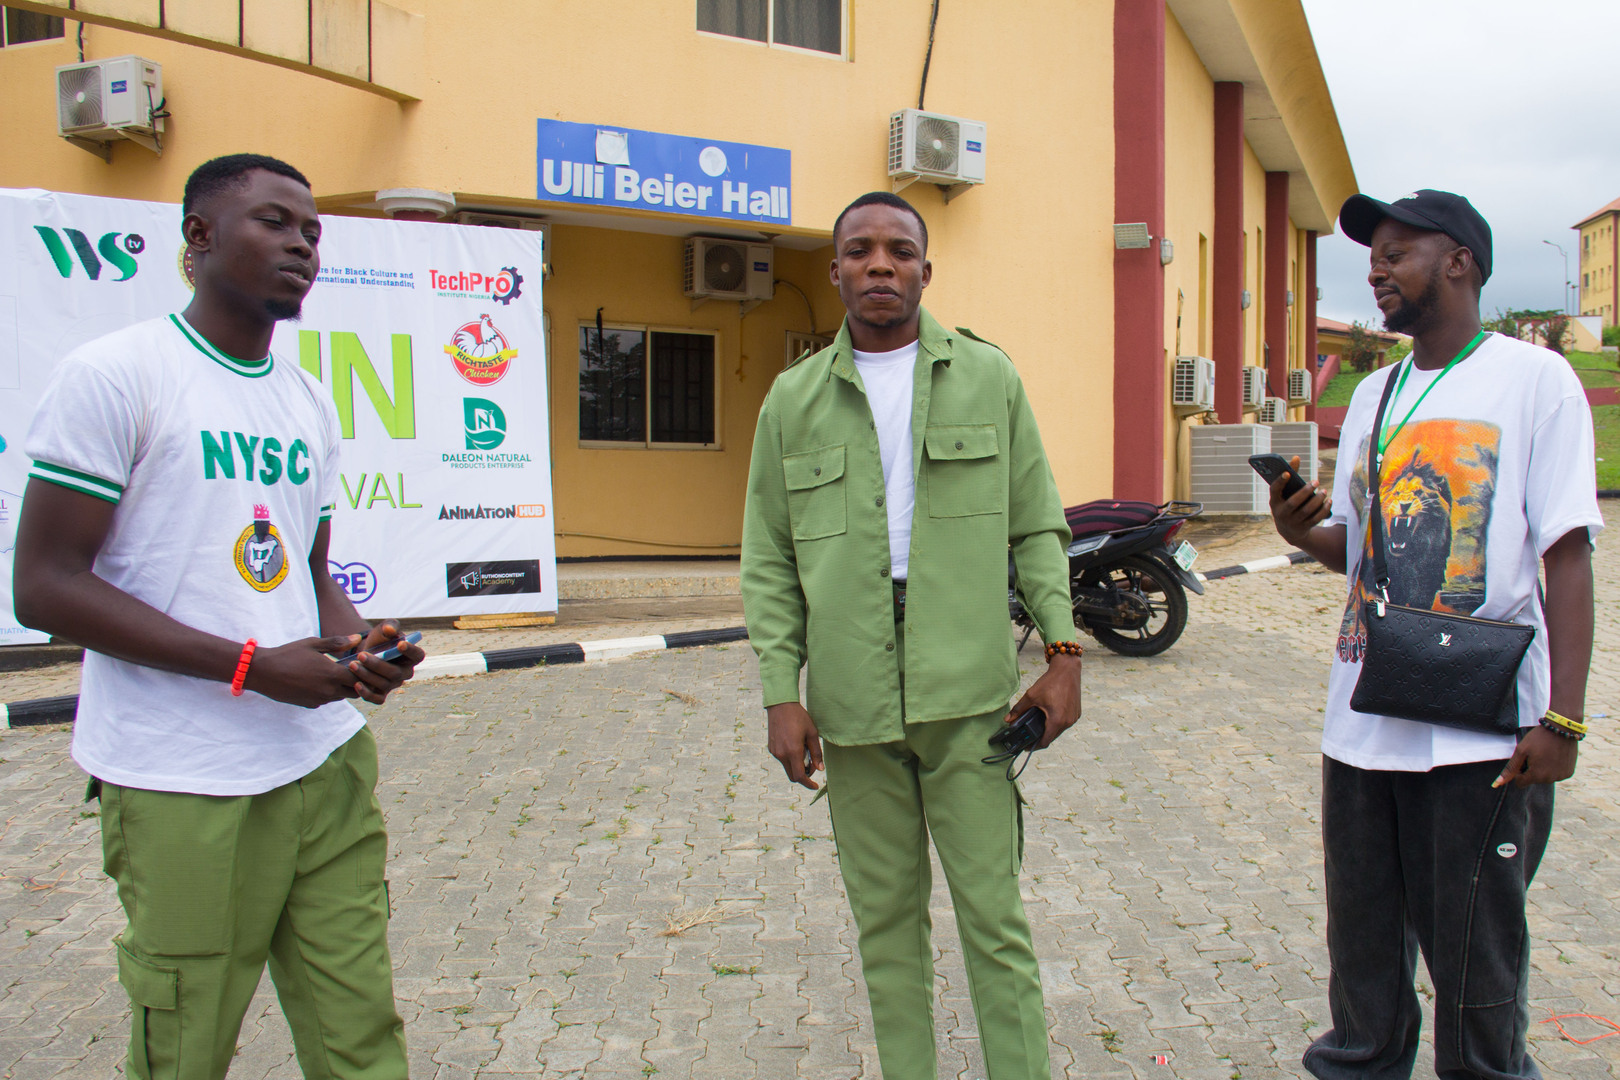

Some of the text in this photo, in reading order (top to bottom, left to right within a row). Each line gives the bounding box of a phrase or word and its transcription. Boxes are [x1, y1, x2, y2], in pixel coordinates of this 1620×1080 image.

[543, 159, 788, 219] Ulli Beier Hall
[331, 267, 342, 275] for
[345, 267, 367, 276] Black
[370, 269, 397, 278] Culture
[316, 276, 357, 285] ernational
[429, 269, 510, 293] TechPro
[456, 351, 504, 368] RICHTASTE
[464, 368, 499, 378] Chicken
[200, 430, 310, 486] NYSC
[442, 453, 531, 462] DALEON NATURAL
[330, 472, 422, 510] VAL
[518, 505, 544, 517] HUB
